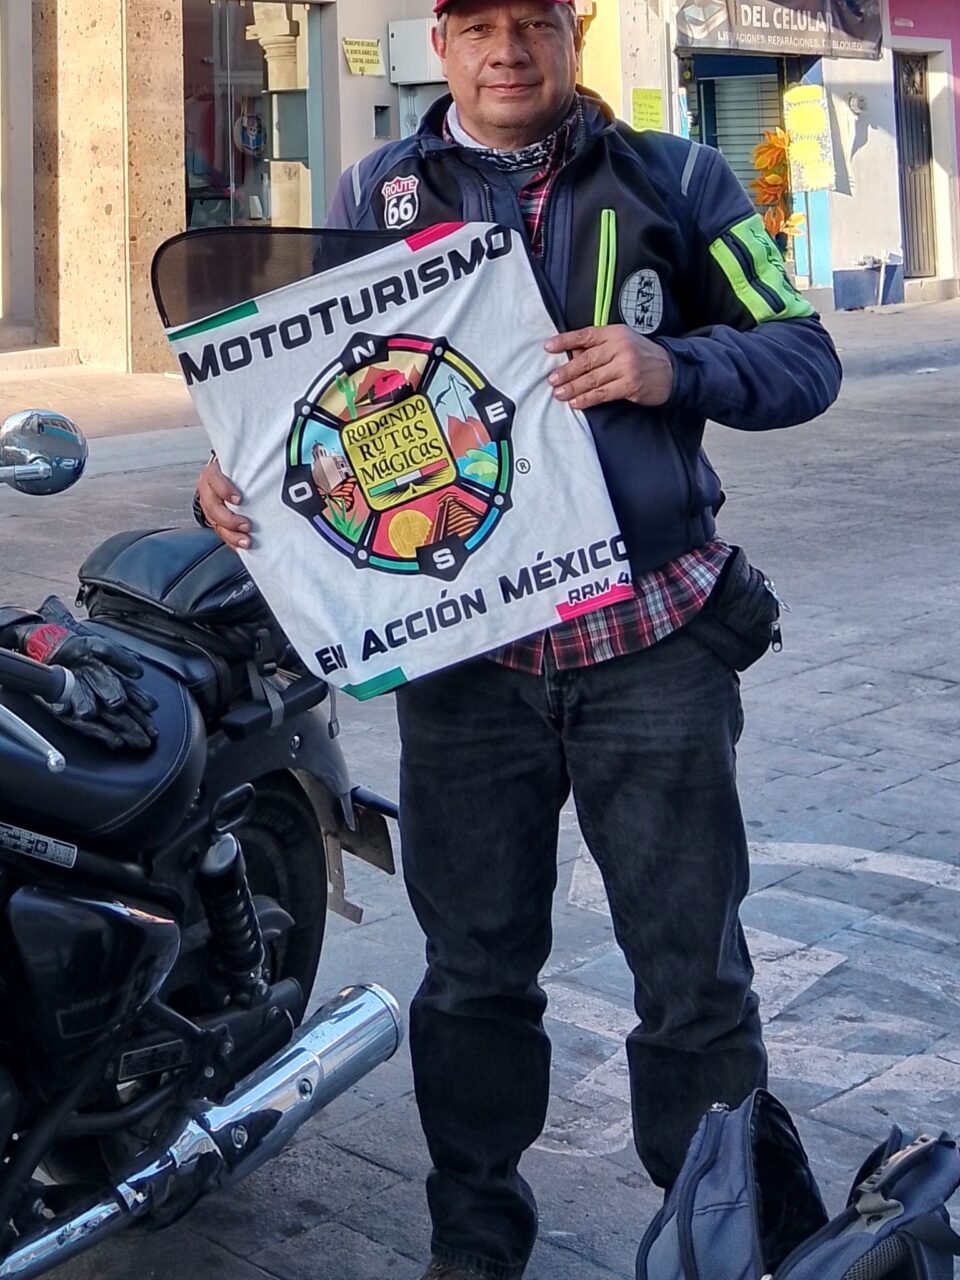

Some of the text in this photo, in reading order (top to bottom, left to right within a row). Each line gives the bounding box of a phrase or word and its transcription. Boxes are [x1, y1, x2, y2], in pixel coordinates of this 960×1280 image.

[740, 4, 835, 33] DEL CELULAR
[385, 180, 415, 196] ROUTE
[387, 193, 414, 225] 66
[177, 225, 513, 386] MOTOTURISMO
[352, 339, 377, 364] N
[484, 400, 509, 424] E
[431, 547, 457, 570] S
[567, 576, 611, 605] RRM
[361, 588, 489, 664] ACCIÓN
